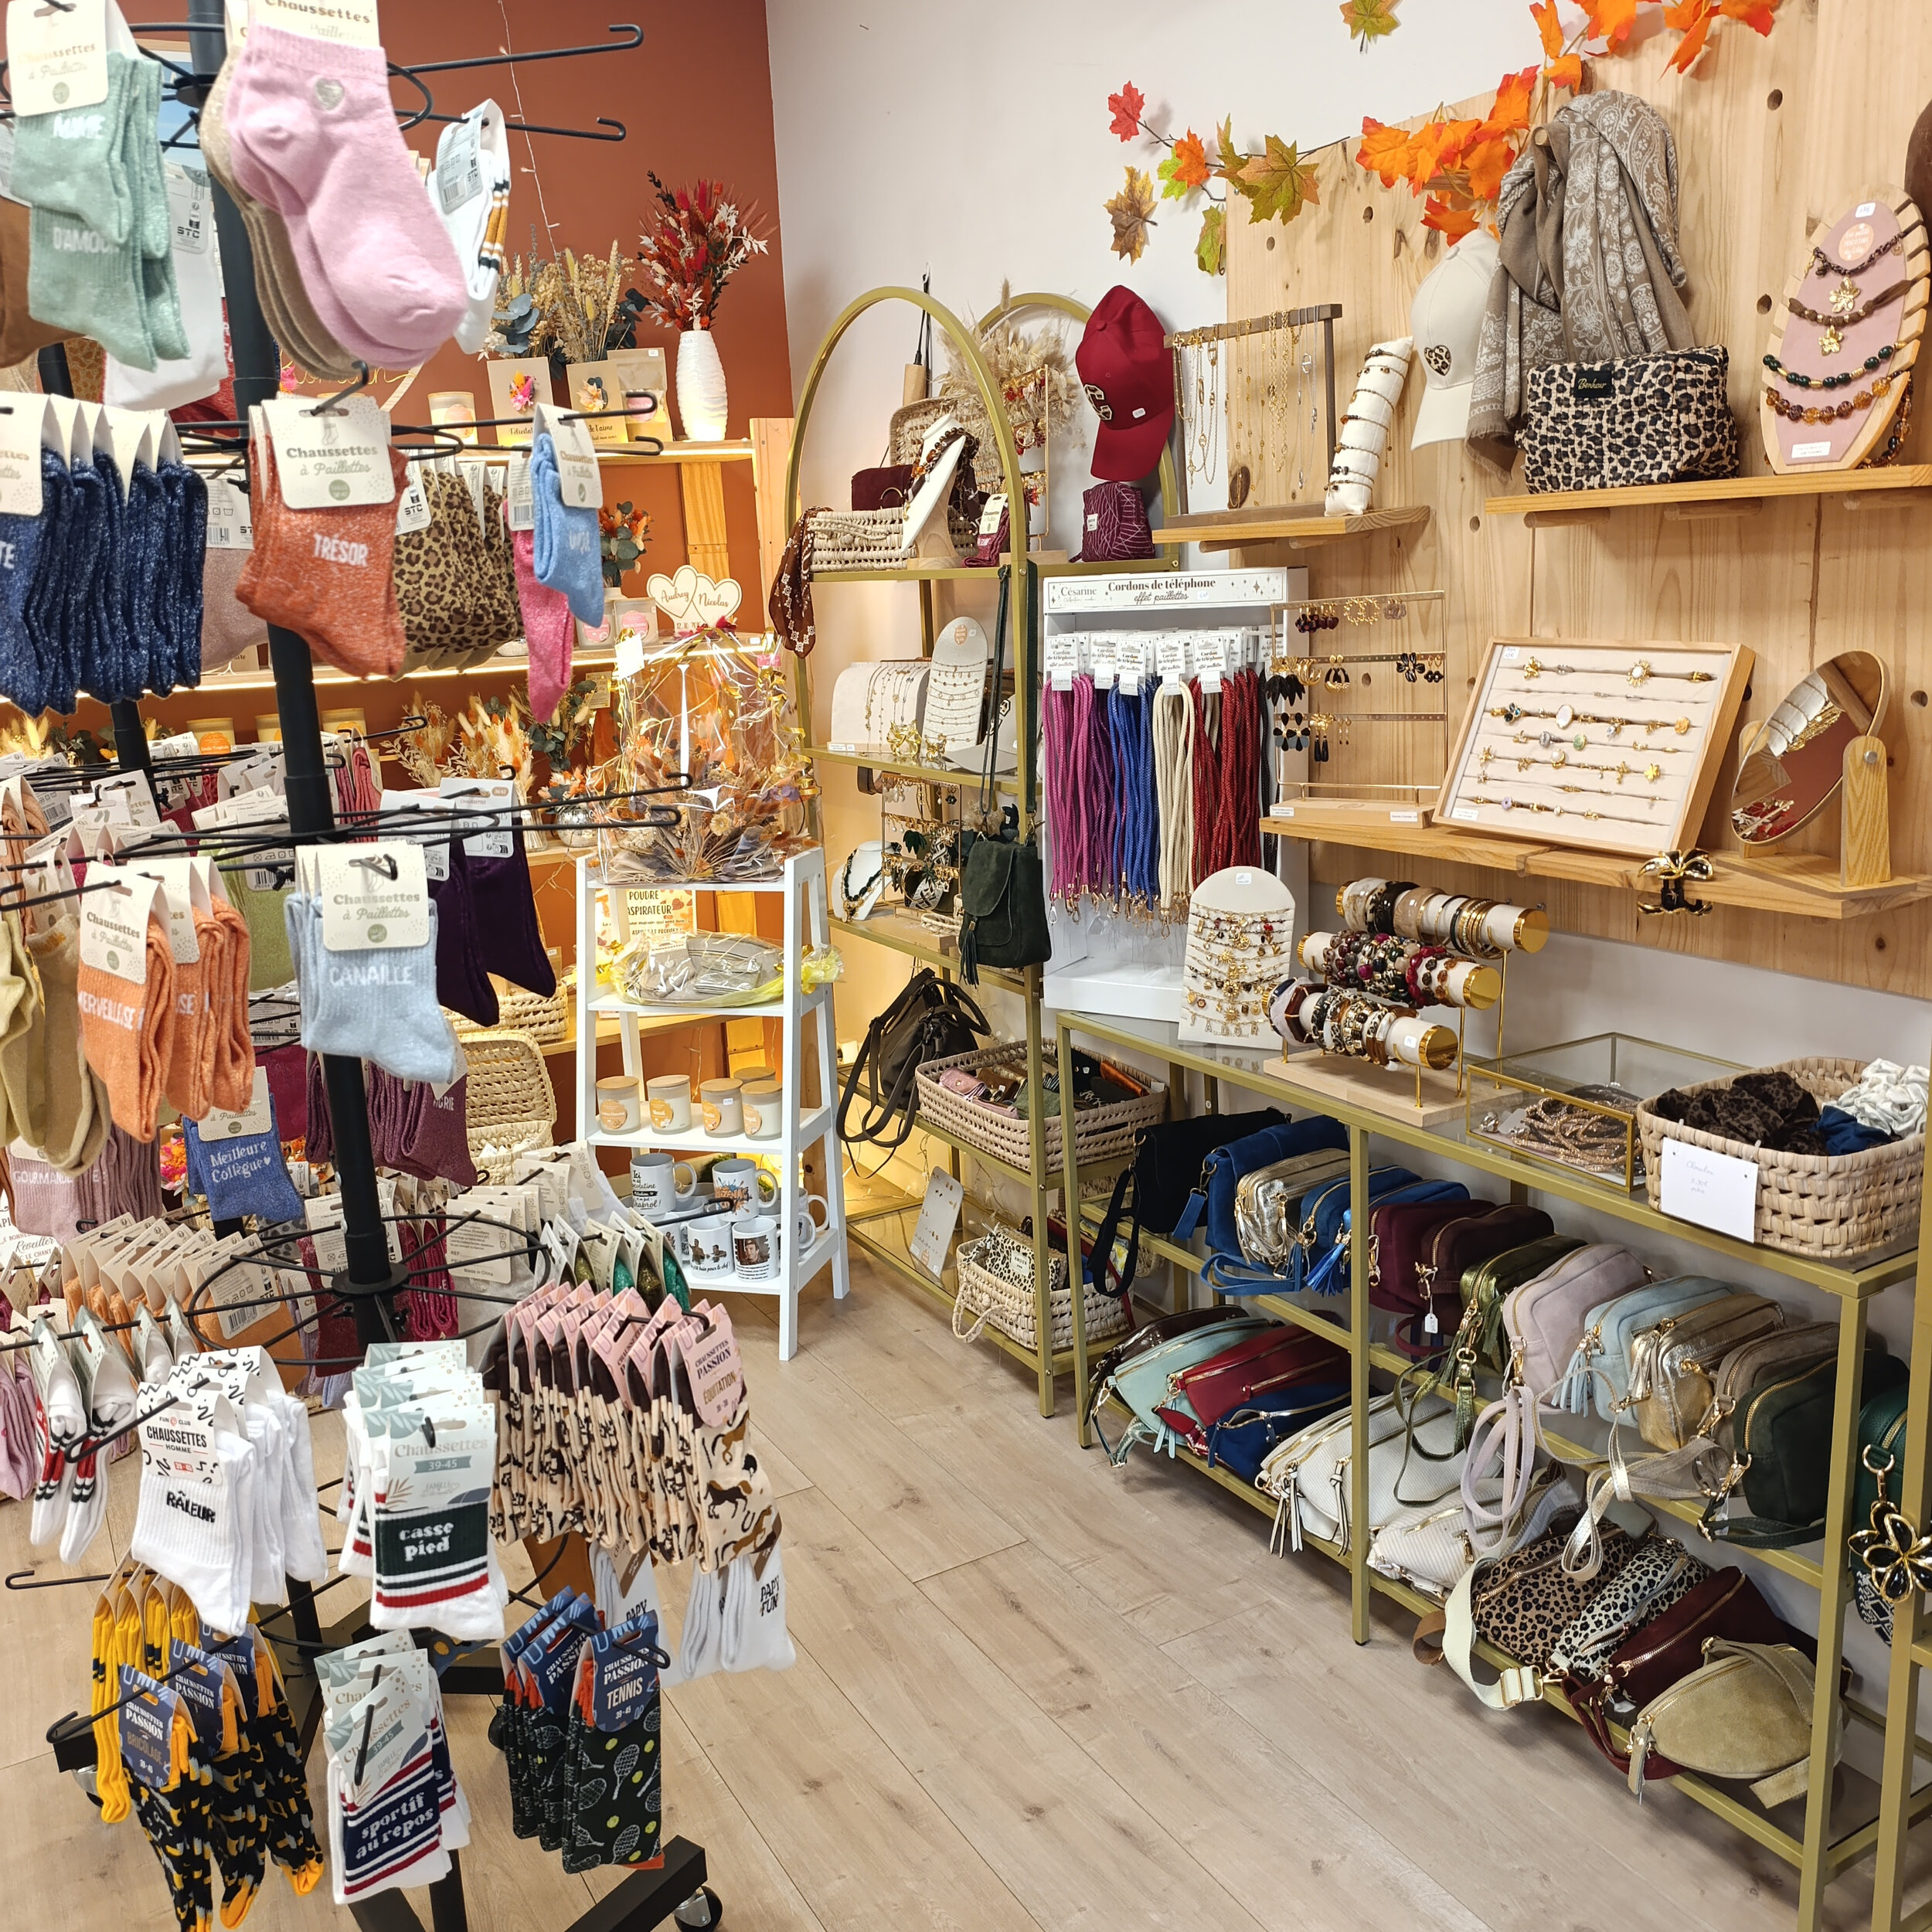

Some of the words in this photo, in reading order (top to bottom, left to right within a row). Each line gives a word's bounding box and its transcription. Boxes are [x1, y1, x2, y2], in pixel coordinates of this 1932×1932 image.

[177, 226, 200, 239] STC
[285, 445, 379, 459] Chaussettes
[300, 464, 309, 475] à
[313, 459, 372, 476] Paillettes
[404, 503, 423, 516] STC
[240, 526, 253, 535] ST
[313, 530, 369, 567] TRÉSOR
[661, 587, 689, 603] Audrey
[1060, 586, 1097, 597] Césarine
[1108, 580, 1149, 592] Cordons
[1151, 580, 1162, 590] de
[1165, 578, 1216, 590] téléphone
[1134, 592, 1152, 605] effet
[1154, 591, 1189, 604] paillettes
[698, 593, 729, 608] Nicolas
[333, 892, 420, 906] Chaussettes
[629, 890, 659, 900] POUDRE
[87, 911, 141, 939] Chaussettes
[342, 909, 352, 920] à
[356, 906, 410, 921] Paillettes
[98, 930, 134, 954] Paillettes
[328, 964, 415, 987] CANAILLE
[209, 1140, 267, 1167] Meilleure
[211, 1156, 264, 1184] Collègue
[695, 1339, 730, 1367] CHAUSSETTES
[696, 1346, 732, 1380] PASSION
[702, 1370, 736, 1406] ÉQUITATION
[179, 1418, 192, 1427] CLUB
[146, 1425, 208, 1448] CHAUSSETTES
[165, 1443, 192, 1454] HOMME
[427, 1459, 458, 1471] 39-45
[166, 1490, 216, 1524] RÂLEUR
[399, 1522, 454, 1541] casse
[404, 1536, 451, 1562] pied
[760, 1574, 780, 1604] PAPY
[760, 1594, 779, 1617] FUN
[546, 1632, 588, 1675] CHAUSSETTE
[548, 1640, 588, 1685] PASSI
[604, 1647, 651, 1672] CHAUSSEES
[604, 1657, 650, 1685] PASSION
[175, 1674, 214, 1699] CHAUSSETTES
[175, 1682, 215, 1710] PASSION
[607, 1676, 644, 1710] TENNIS
[126, 1701, 164, 1729] CHAUSSETTES
[126, 1708, 164, 1742] PASSION
[344, 1699, 411, 1764] Chssettes
[127, 1730, 163, 1764] BRICOLAGE
[361, 1791, 424, 1840] sportif
[356, 1838, 379, 1860] au
[380, 1807, 434, 1844] repos
